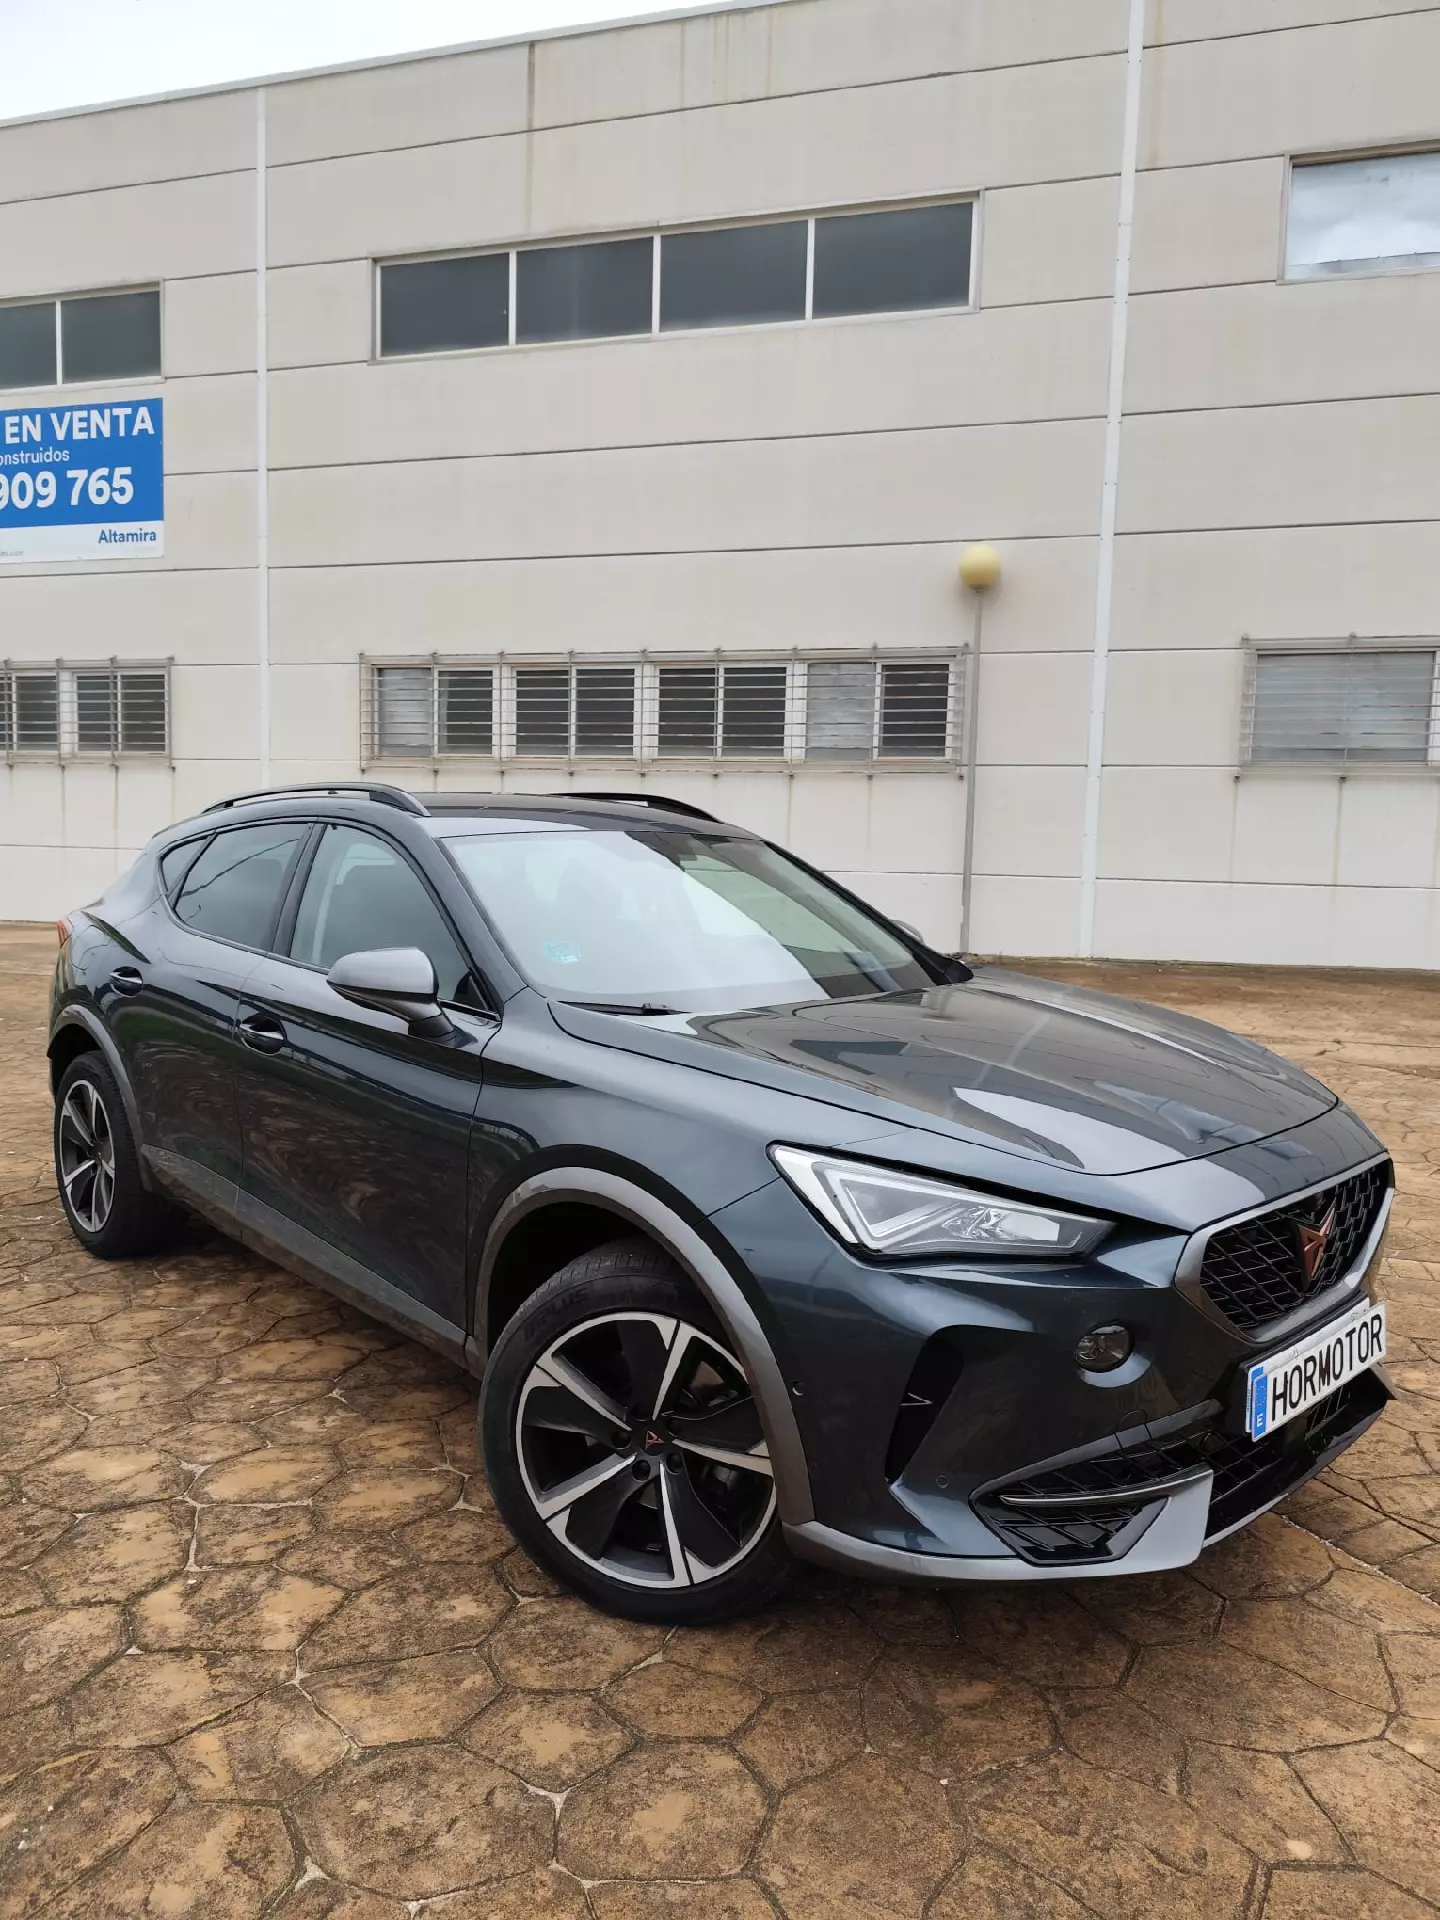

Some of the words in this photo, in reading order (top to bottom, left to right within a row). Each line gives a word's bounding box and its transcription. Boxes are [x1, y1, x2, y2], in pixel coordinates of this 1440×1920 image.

[5, 414, 42, 444] EN
[50, 406, 155, 440] VENTA
[66, 466, 134, 506] 765
[98, 528, 157, 544] Altamira
[1271, 1313, 1383, 1422] HORMOTOR
[1256, 1413, 1264, 1428] E
